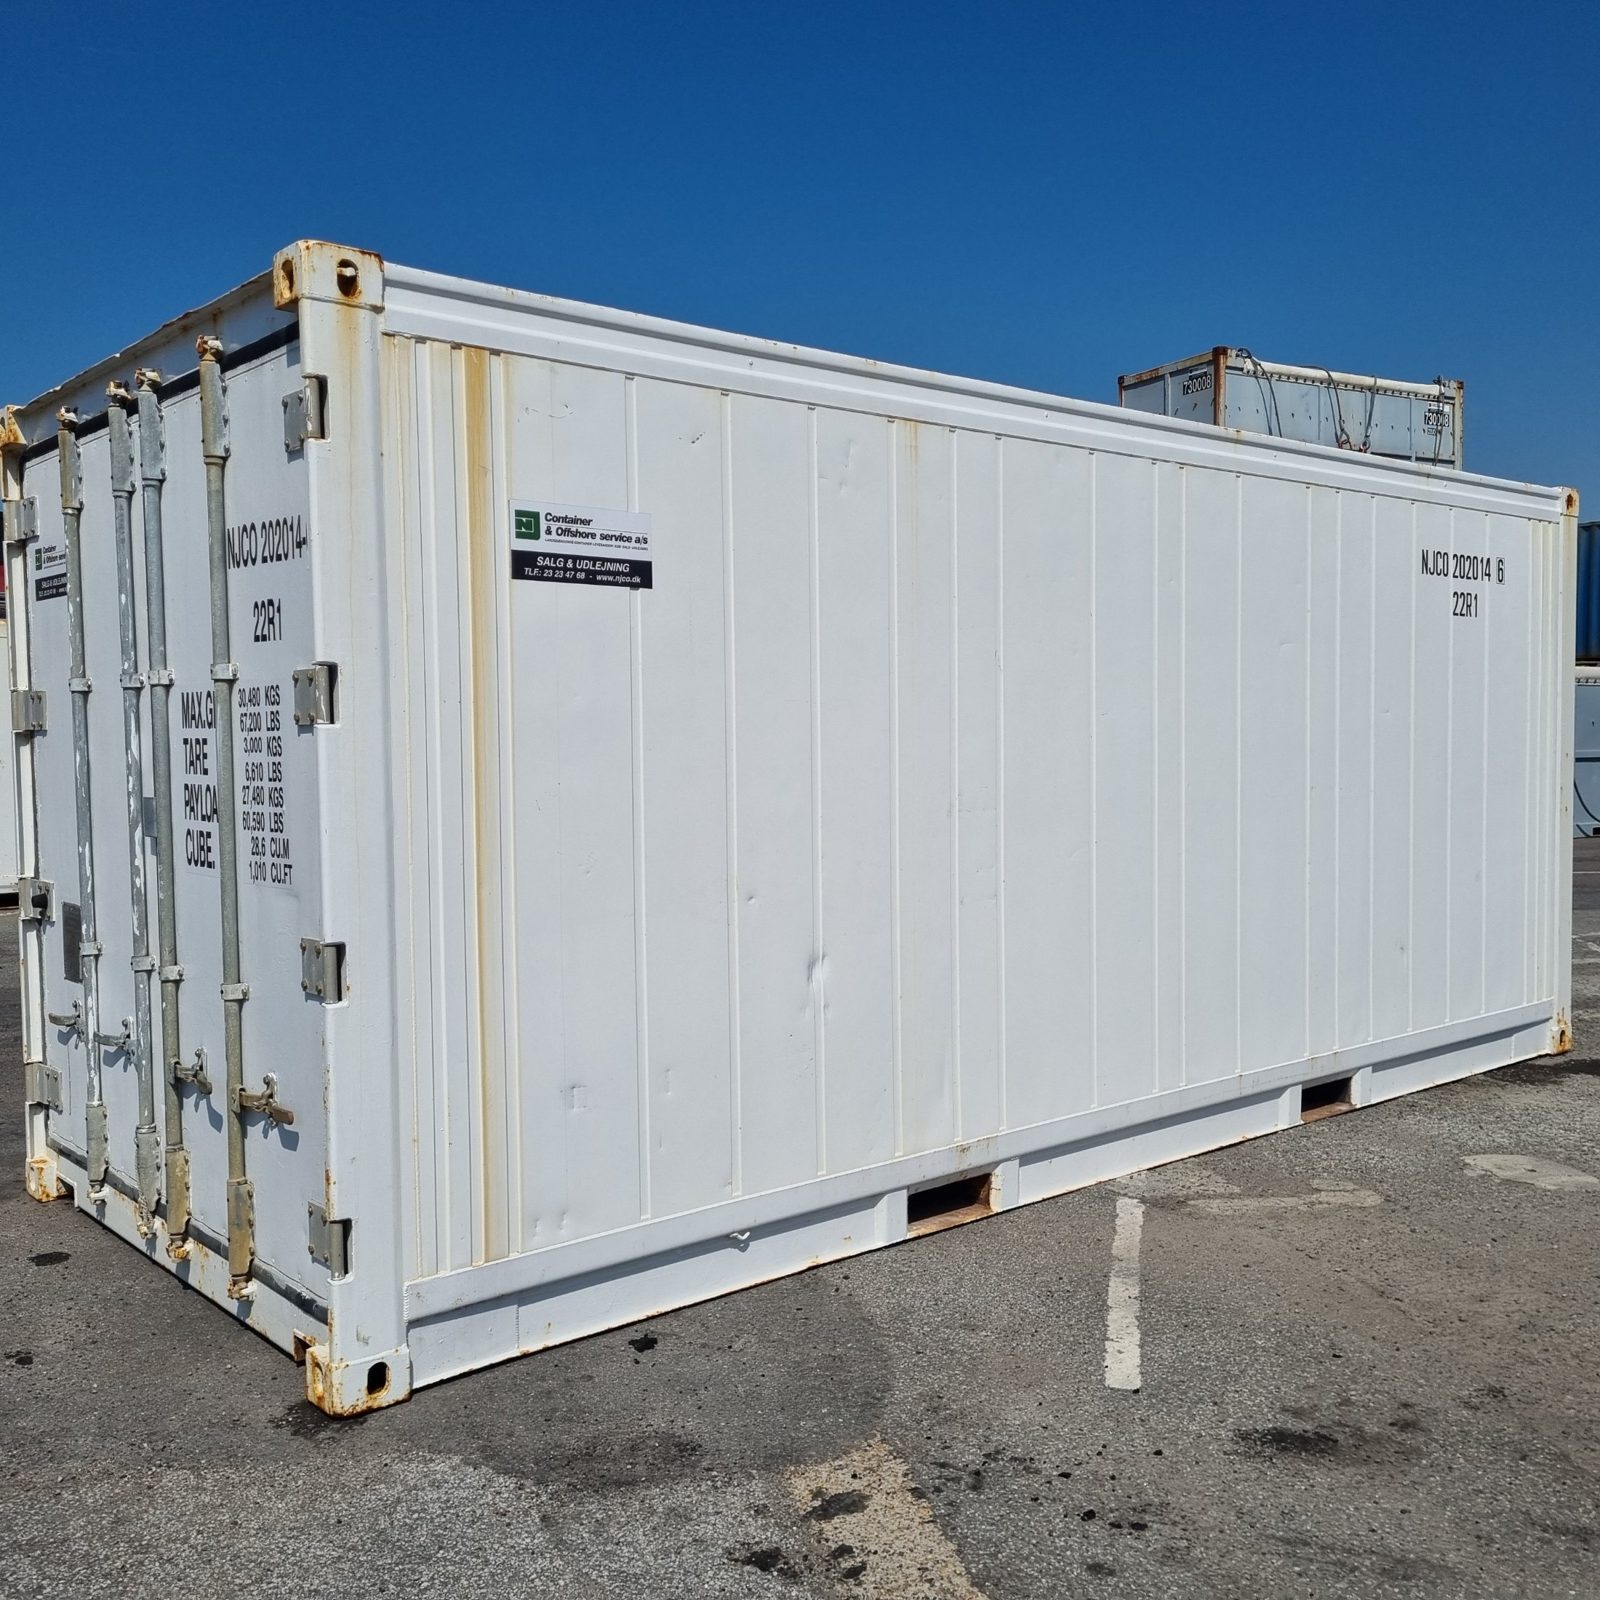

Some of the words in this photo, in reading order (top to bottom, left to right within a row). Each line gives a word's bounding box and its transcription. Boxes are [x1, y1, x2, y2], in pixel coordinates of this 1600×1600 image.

[1183, 375, 1211, 395] 730008
[544, 512, 593, 526] Container
[227, 522, 258, 570] NJCO
[261, 514, 304, 564] 202014
[545, 526, 552, 536] &
[555, 526, 597, 540] Offshore
[599, 532, 632, 543] service
[634, 535, 648, 545] a/s
[536, 556, 564, 568] SALG
[566, 559, 573, 568] &
[576, 560, 630, 572] UDLEJNING
[1421, 549, 1449, 577] NJCO
[1452, 553, 1491, 582] 202014
[1497, 559, 1504, 583] 6
[543, 569, 553, 577] 23
[554, 570, 564, 578] 23
[565, 570, 575, 579] 47
[576, 571, 586, 580] 68
[596, 574, 641, 584] www.njco.dk
[1452, 591, 1478, 618] 22R1
[253, 598, 282, 643] 22R1
[181, 690, 216, 729] MAX.G
[238, 687, 261, 710] 30,480
[264, 684, 281, 707] KGS
[239, 711, 262, 736] 67,200
[266, 711, 281, 732] LBS
[183, 737, 209, 776] TARE
[243, 736, 263, 757] 3,000
[266, 736, 283, 757] KGS
[245, 762, 264, 785] 6,610
[267, 762, 282, 783] LBS
[184, 783, 219, 823] PAYLOA
[242, 785, 265, 809] 27,480
[268, 786, 284, 809] KGS
[242, 811, 265, 835] 60,590
[269, 812, 284, 834] LBS
[251, 836, 266, 860] 28,6
[269, 837, 290, 860] CU.M
[249, 863, 267, 885] 1,010
[270, 864, 293, 885] CU.FT
